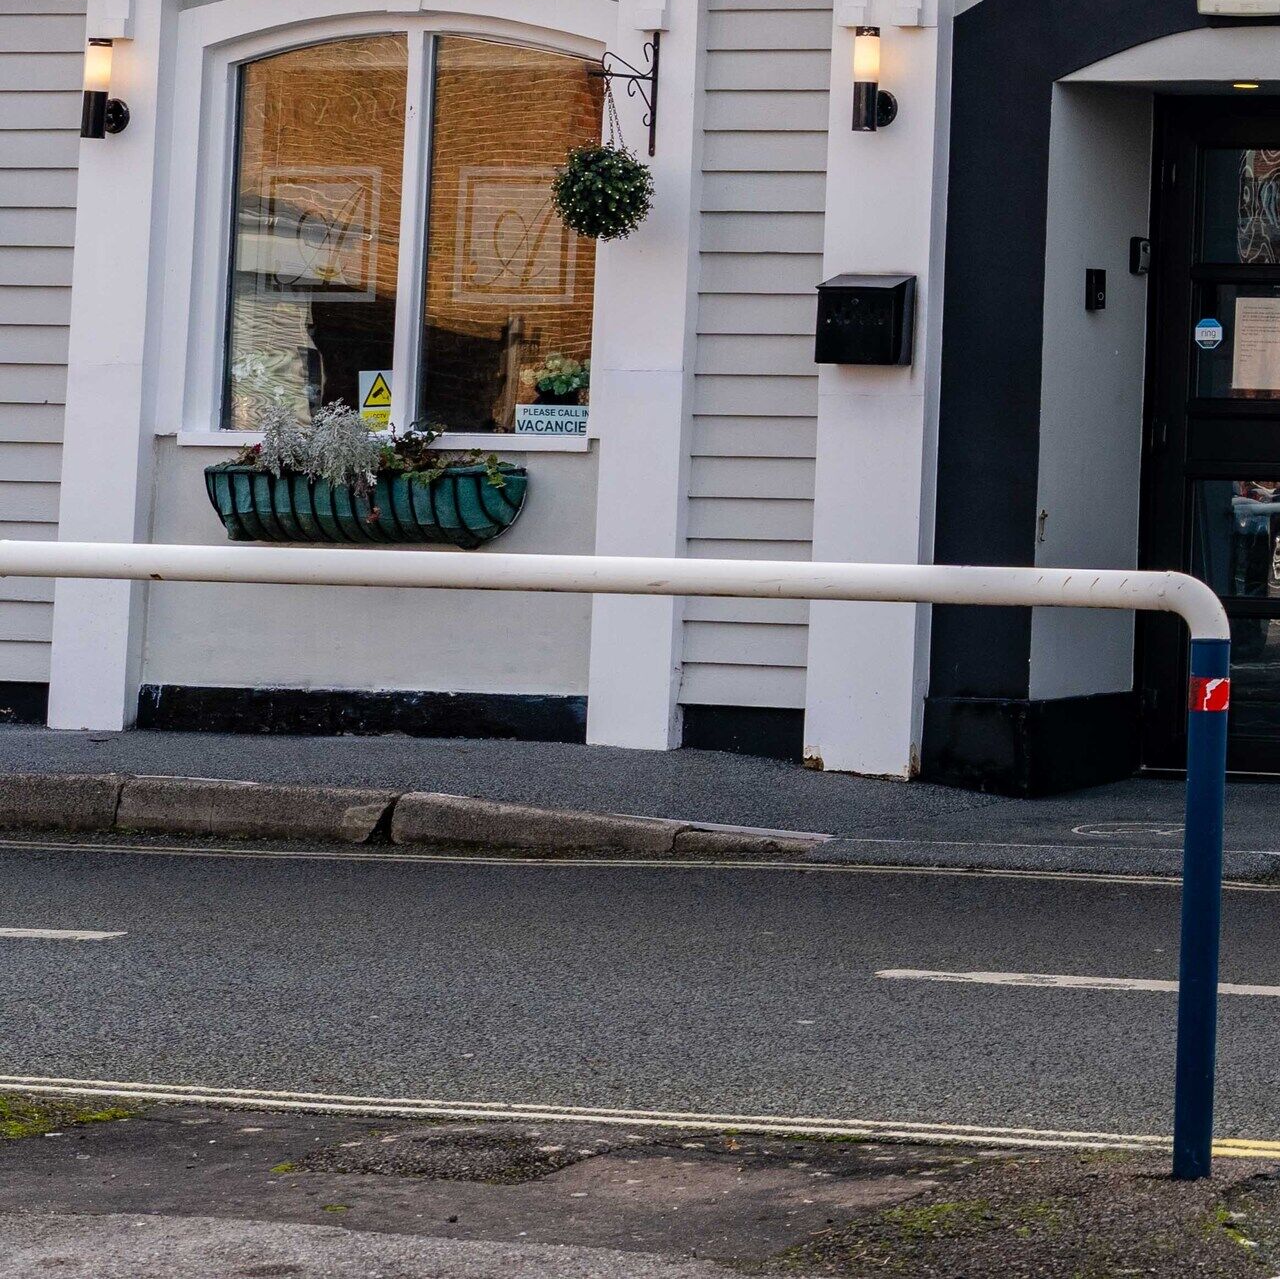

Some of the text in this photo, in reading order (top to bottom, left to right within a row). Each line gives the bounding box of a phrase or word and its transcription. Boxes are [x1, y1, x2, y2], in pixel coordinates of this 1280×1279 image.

[1201, 328, 1216, 339] ring
[523, 408, 556, 416] PLEASE
[557, 409, 580, 417] CALL
